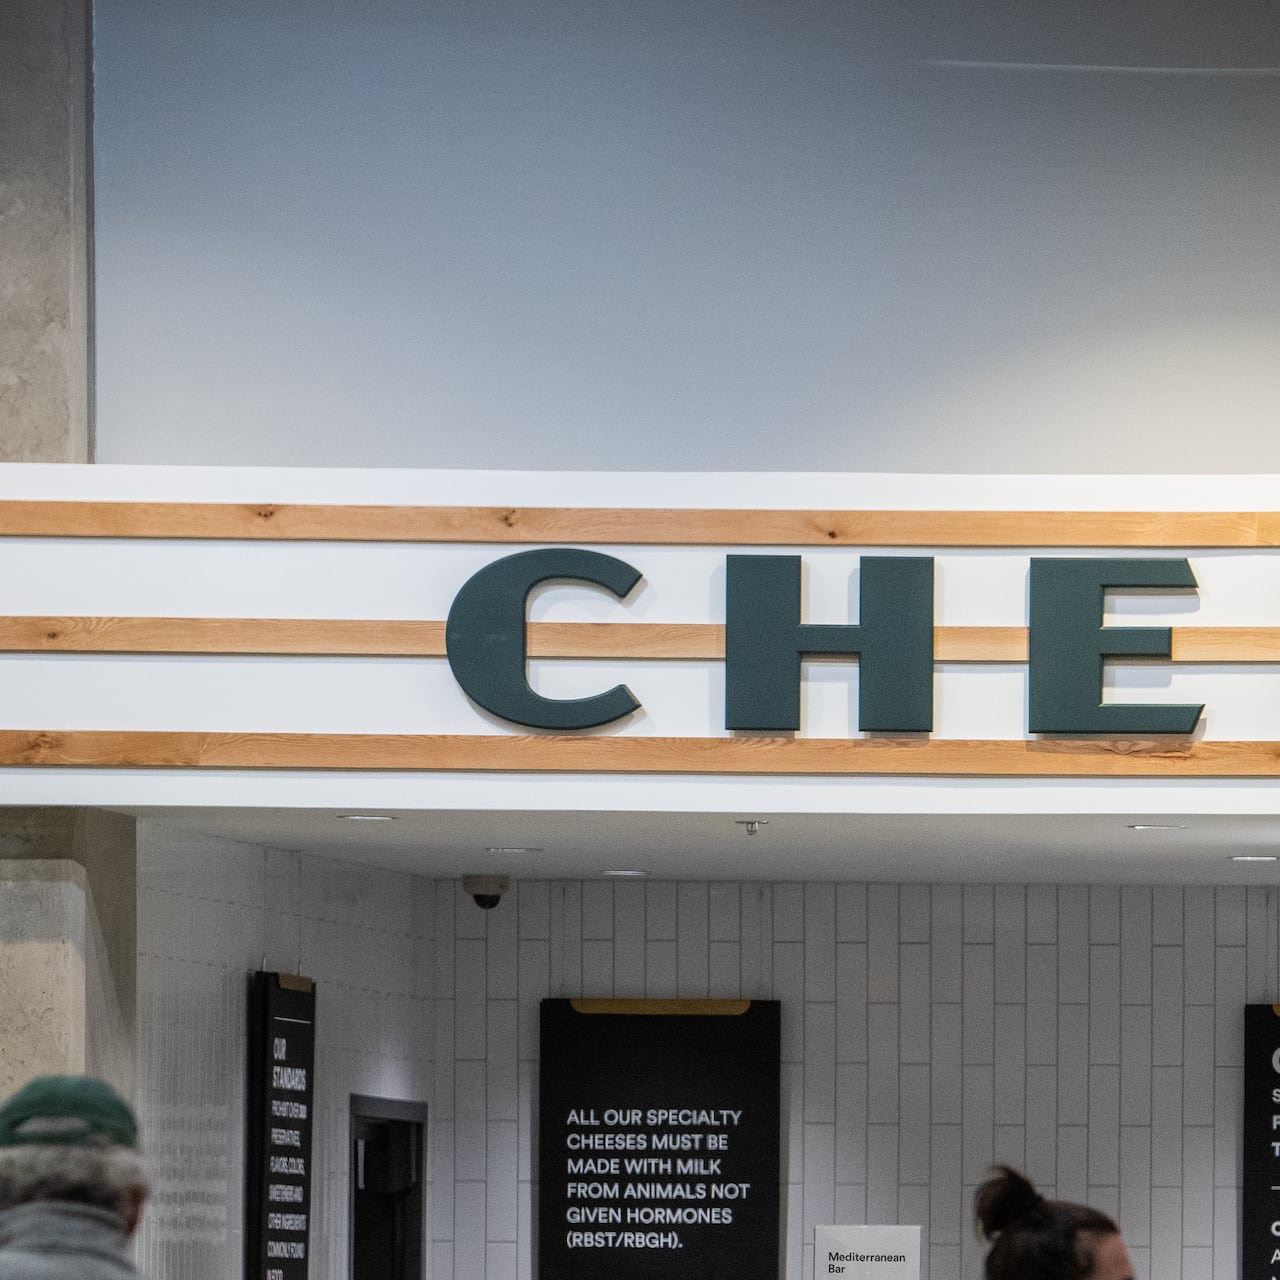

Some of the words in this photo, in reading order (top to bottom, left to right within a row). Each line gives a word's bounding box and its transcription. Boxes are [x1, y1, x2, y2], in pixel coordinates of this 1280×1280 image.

[273, 1037, 287, 1061] OUR
[272, 1066, 307, 1091] STANDARDS
[567, 1109, 600, 1126] ALL
[604, 1109, 642, 1126] OUR
[647, 1109, 742, 1126] SPECIALTY
[567, 1133, 647, 1150] CHEESES
[652, 1133, 703, 1150] MUST
[707, 1134, 728, 1150] BE
[567, 1158, 620, 1174] MADE
[624, 1158, 672, 1174] WITH
[676, 1158, 721, 1175] MILK
[567, 1182, 619, 1199] FROM
[623, 1182, 707, 1200] ANIMALS
[711, 1183, 750, 1199] NOT
[566, 1207, 622, 1224] GIVEN
[626, 1207, 732, 1224] HORMONES
[566, 1231, 683, 1249] (RBST/RBGH).
[828, 1252, 906, 1262] Mediterranean
[828, 1264, 846, 1273] Bar
